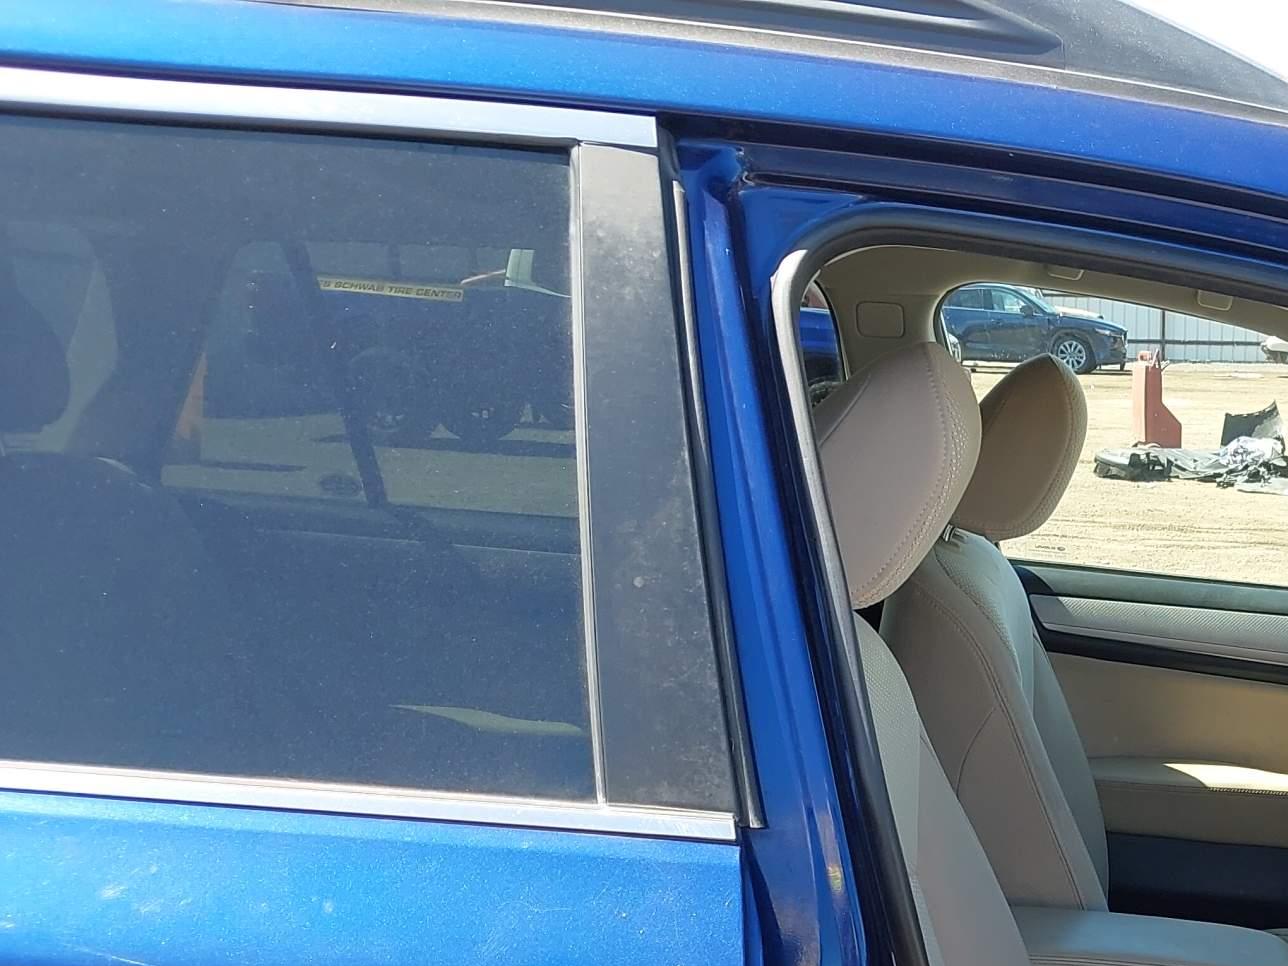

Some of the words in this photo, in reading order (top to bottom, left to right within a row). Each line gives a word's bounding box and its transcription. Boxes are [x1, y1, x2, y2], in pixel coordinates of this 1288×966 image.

[334, 281, 385, 293] SCHWAB
[387, 286, 413, 296] TIRE
[415, 288, 462, 300] CENTER
